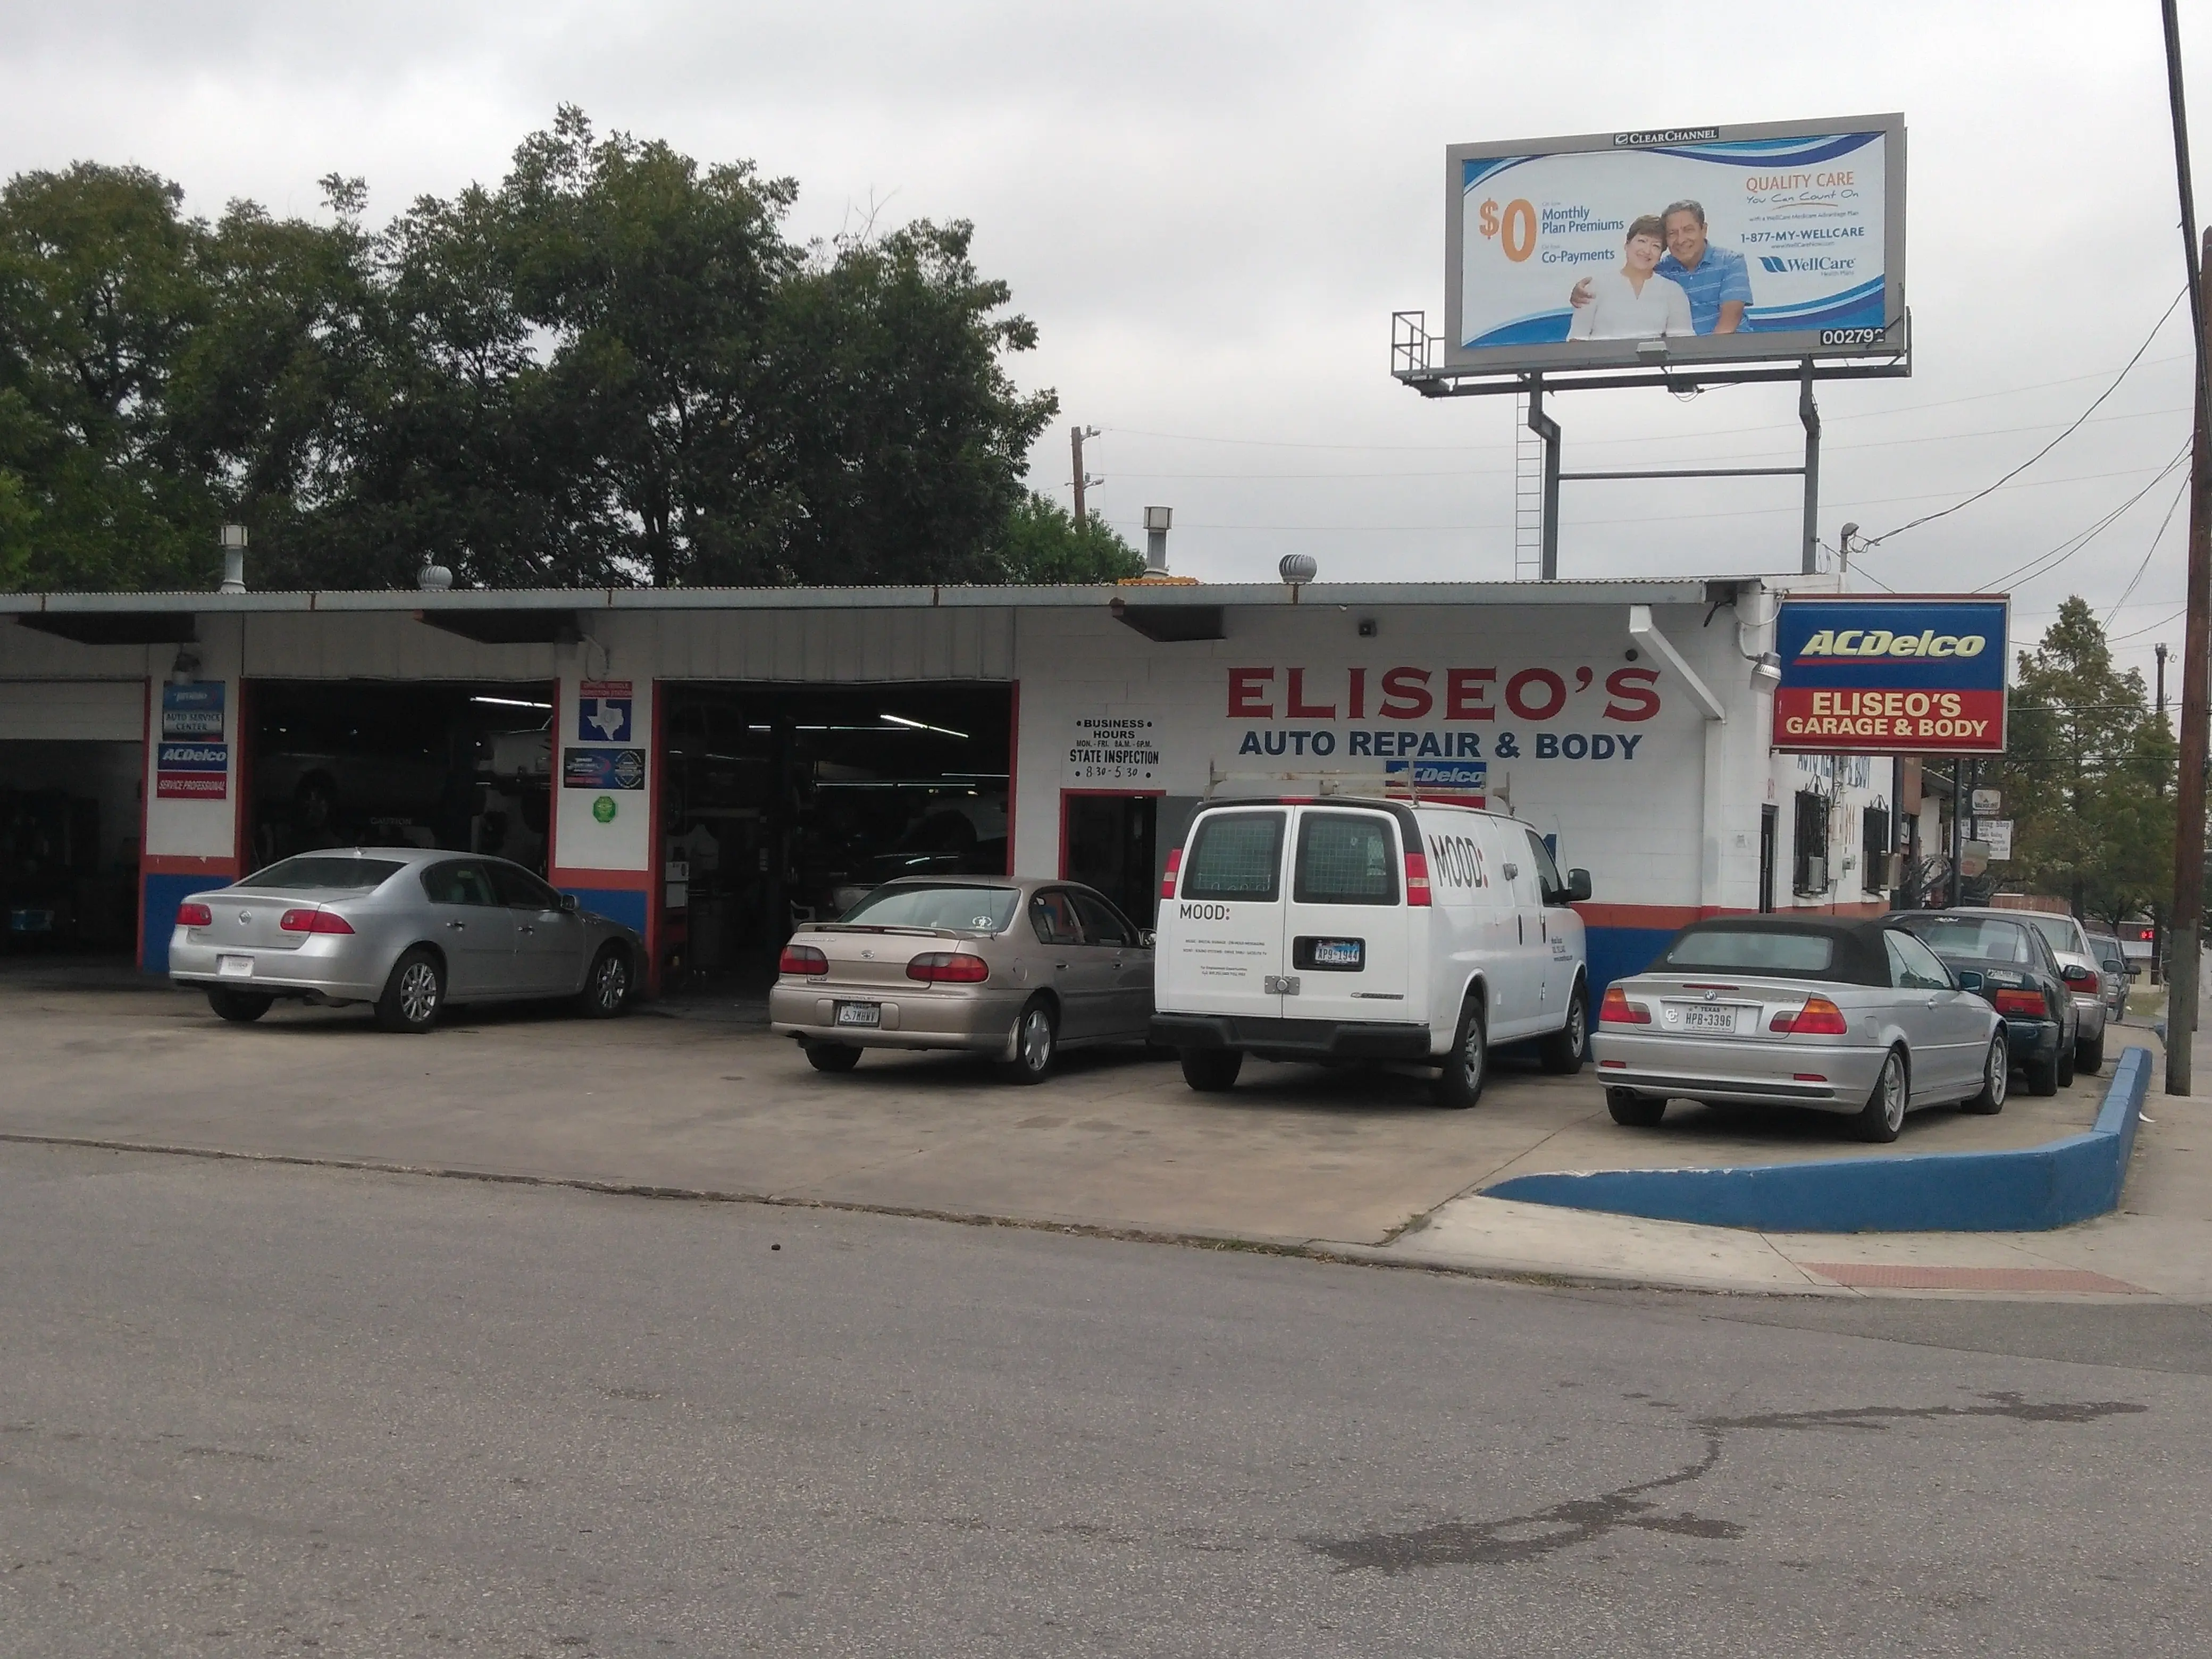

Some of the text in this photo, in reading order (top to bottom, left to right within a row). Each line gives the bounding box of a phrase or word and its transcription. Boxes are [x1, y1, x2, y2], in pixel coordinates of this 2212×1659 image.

[1746, 171, 1854, 193] QUALITY CARE
[1771, 194, 1794, 203] Can
[1799, 191, 1836, 200] Count
[1841, 189, 1858, 199] On
[1542, 205, 1590, 221] Monthly
[1479, 197, 1537, 263] $0
[1542, 219, 1624, 234] Plan Premiums
[1741, 227, 1865, 243] 1-877-MY-WELLCARE
[1542, 249, 1615, 264] Co-Payments
[1799, 629, 1986, 658] ACDelco
[1226, 666, 1662, 722] ELISEO'S
[1813, 692, 1962, 718] ELISEO'S
[1084, 719, 1144, 728] BUSINESS
[1786, 717, 1989, 738] GARAGE & BODY
[1093, 730, 1135, 739] HOURS
[1238, 731, 1643, 760] AUTO REPAIR & BODY
[162, 748, 227, 761] ACDelco
[1070, 749, 1159, 765] STATE INSPECTION
[1180, 903, 1230, 920] MOOD:
